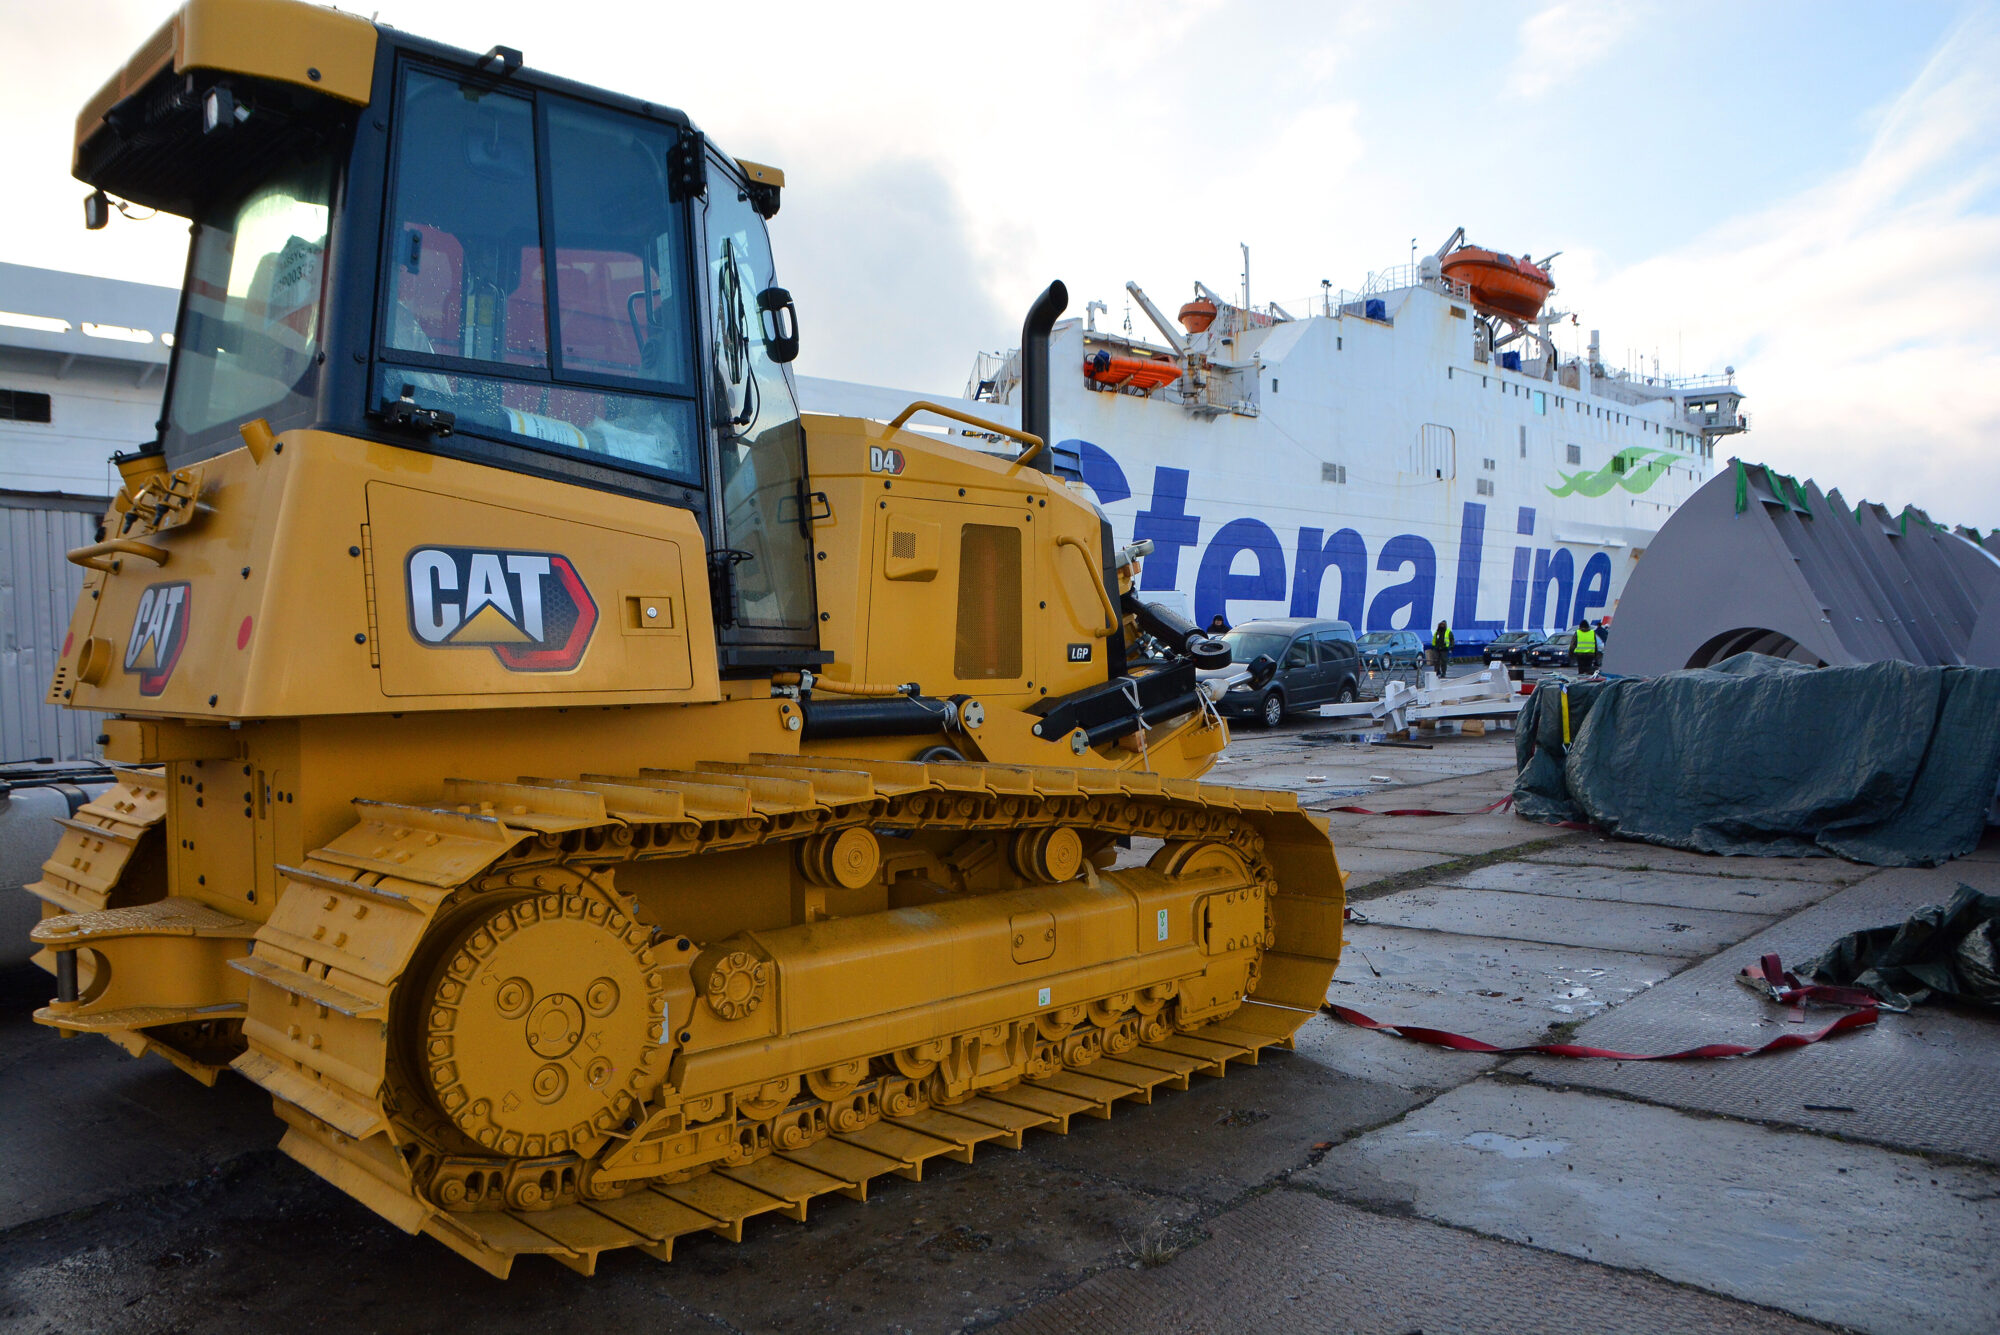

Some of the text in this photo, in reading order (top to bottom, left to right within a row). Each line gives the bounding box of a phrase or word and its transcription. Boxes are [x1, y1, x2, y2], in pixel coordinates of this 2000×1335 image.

[870, 447, 895, 474] D4
[409, 549, 551, 643] CAT
[1452, 501, 1612, 632] Line
[126, 585, 186, 669] CAT
[1071, 647, 1089, 660] LGP
